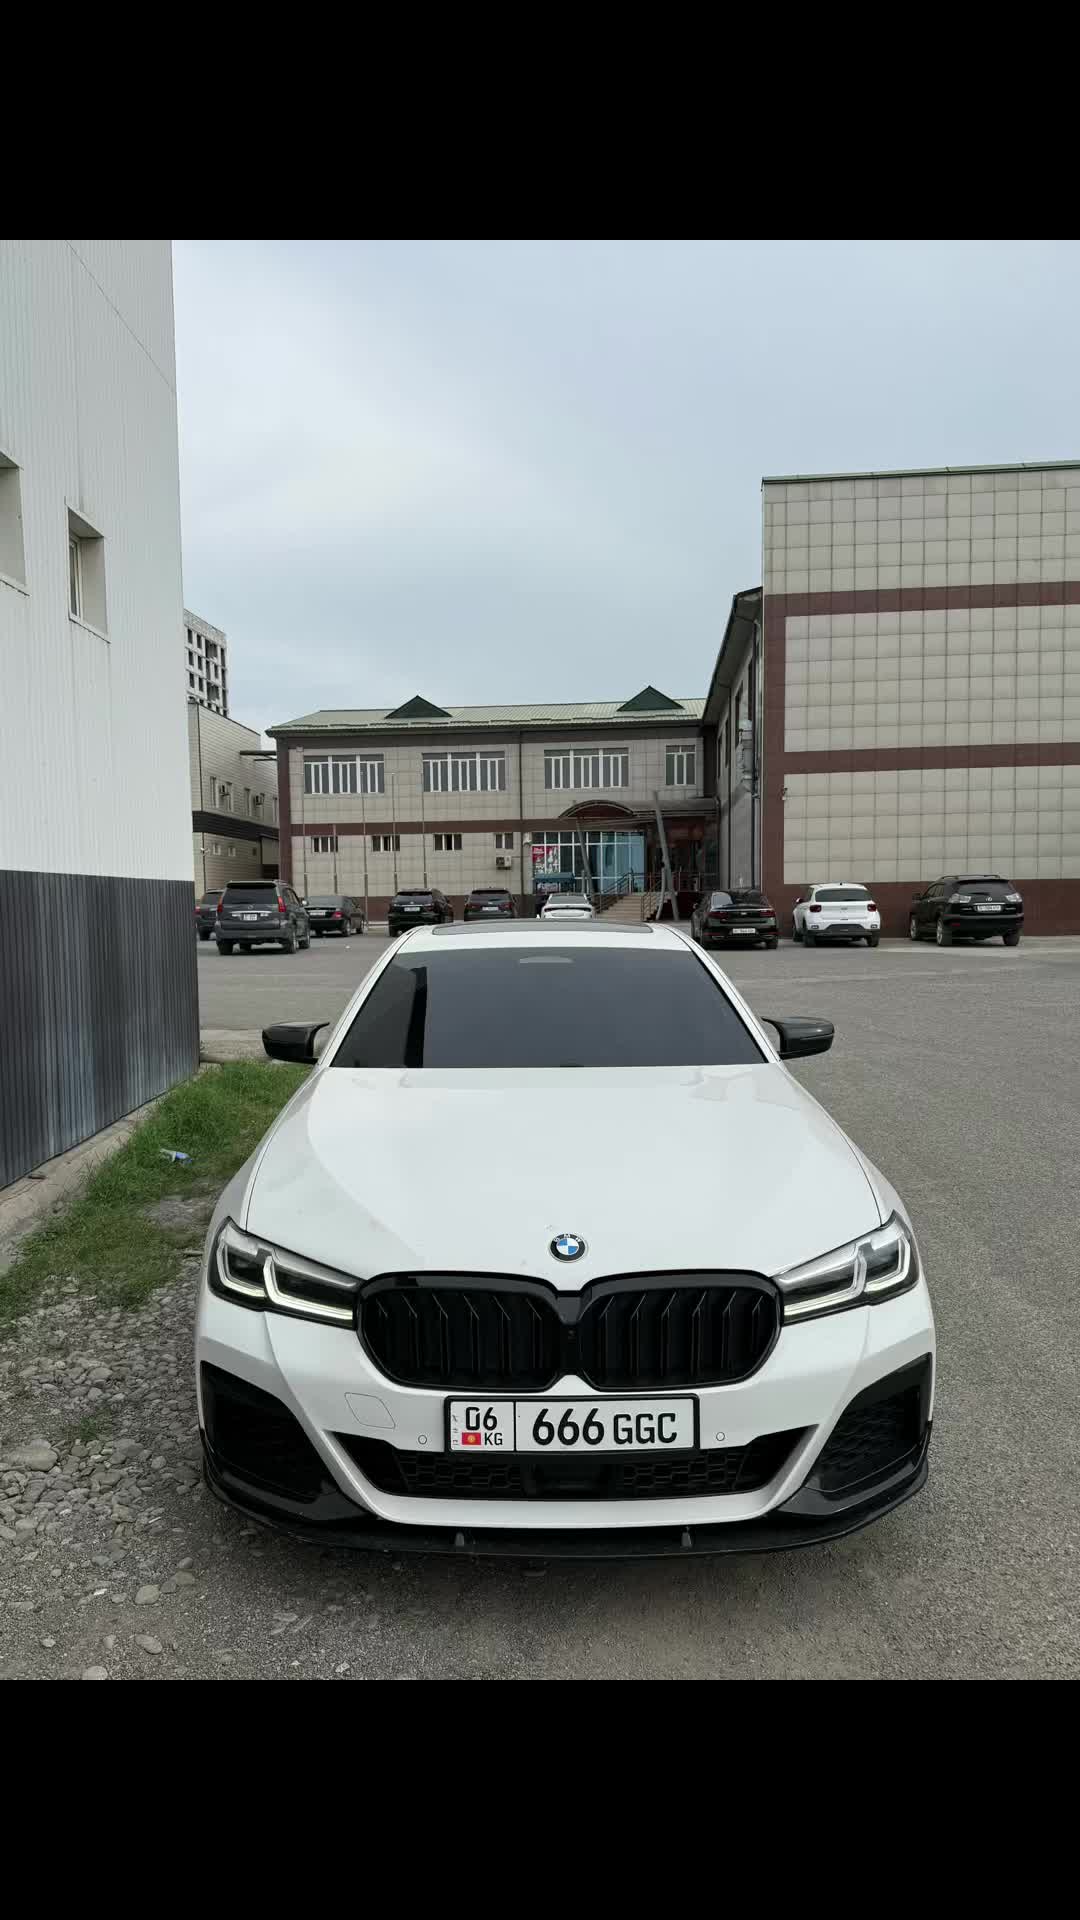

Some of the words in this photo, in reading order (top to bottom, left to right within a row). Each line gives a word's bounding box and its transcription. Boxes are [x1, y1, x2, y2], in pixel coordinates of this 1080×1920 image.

[465, 1406, 498, 1431] 06
[532, 1407, 605, 1446] 666
[613, 1412, 678, 1445] GGC
[484, 1432, 503, 1446] KG
